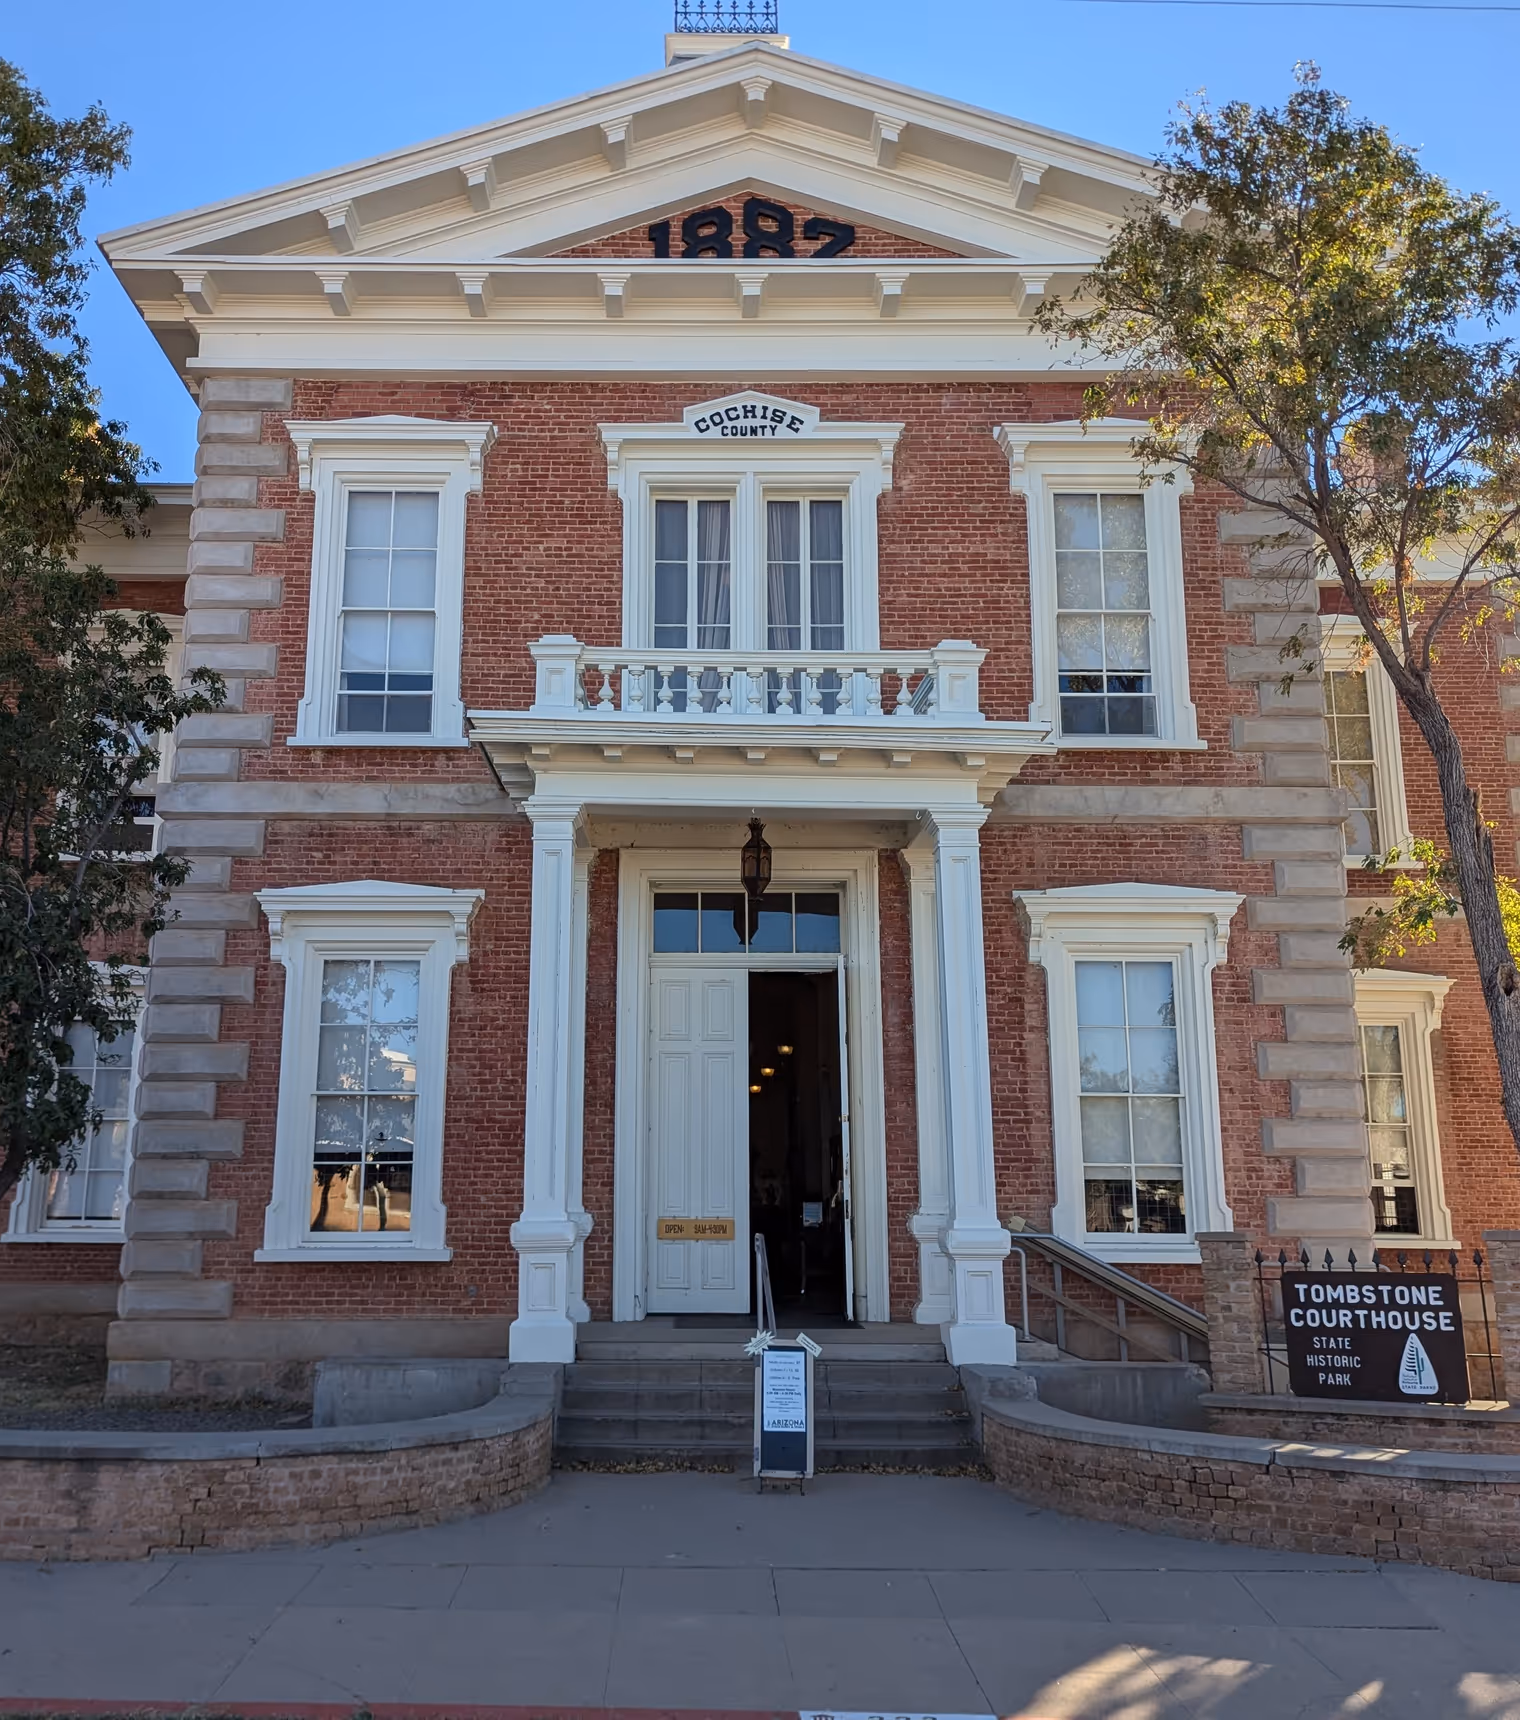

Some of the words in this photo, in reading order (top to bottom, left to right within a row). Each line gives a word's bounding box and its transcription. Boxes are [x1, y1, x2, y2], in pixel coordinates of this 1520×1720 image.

[649, 197, 855, 258] 1887
[694, 405, 804, 433] COCHISE
[721, 425, 778, 436] COUNTY
[664, 1224, 685, 1234] OPEN:
[1294, 1284, 1444, 1305] TOMBSTONE
[1290, 1308, 1455, 1331] COURTHOUSE
[1313, 1336, 1351, 1349] STATE
[1306, 1354, 1361, 1368] HISTORIC
[1319, 1373, 1351, 1386] PARK
